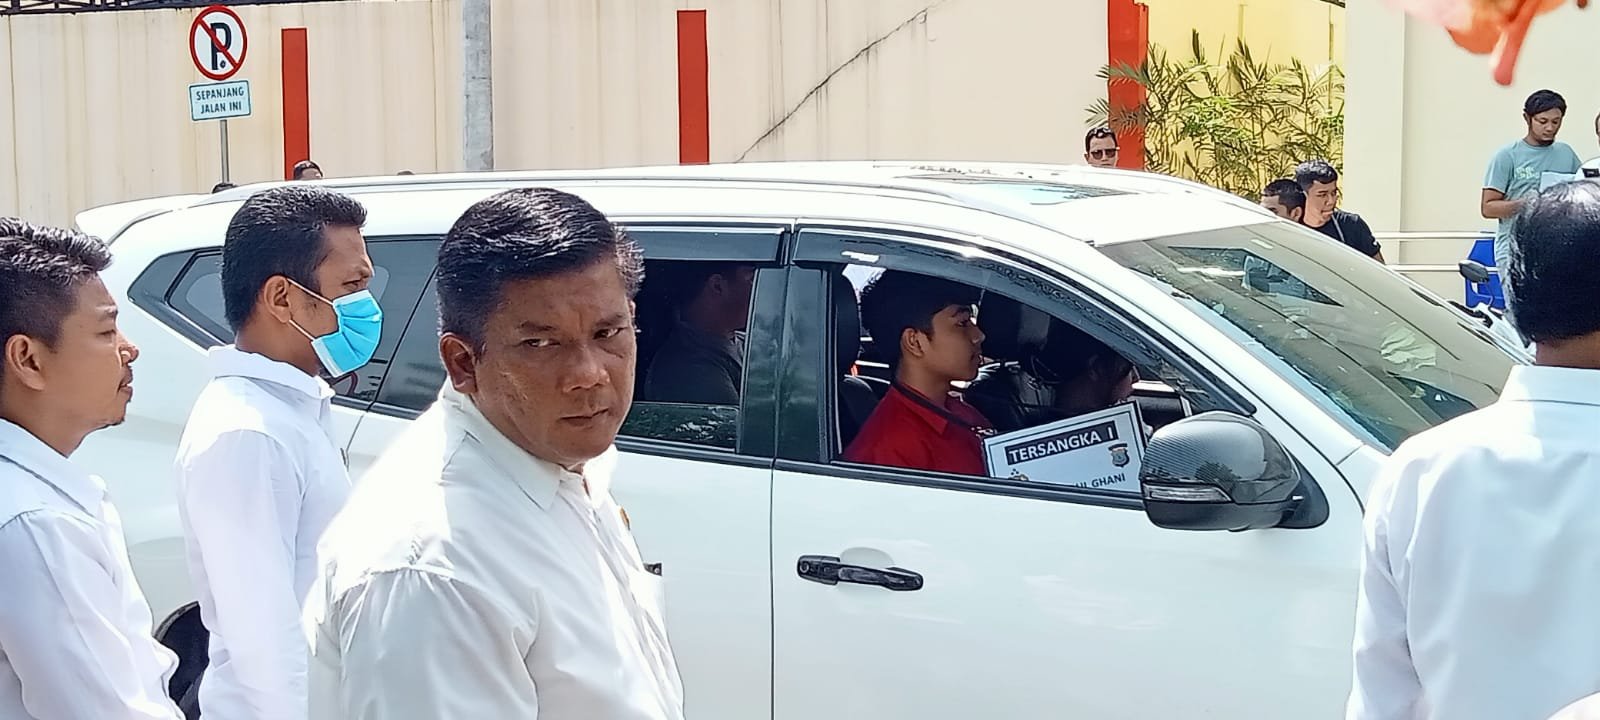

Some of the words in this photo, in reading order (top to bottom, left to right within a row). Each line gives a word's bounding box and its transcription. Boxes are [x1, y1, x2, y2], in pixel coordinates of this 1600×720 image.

[196, 86, 245, 101] SEPANJANG
[200, 103, 226, 115] JALAN
[229, 101, 242, 111] INI
[1008, 430, 1102, 463] TERSANGKA
[1091, 472, 1126, 488] GHANI
